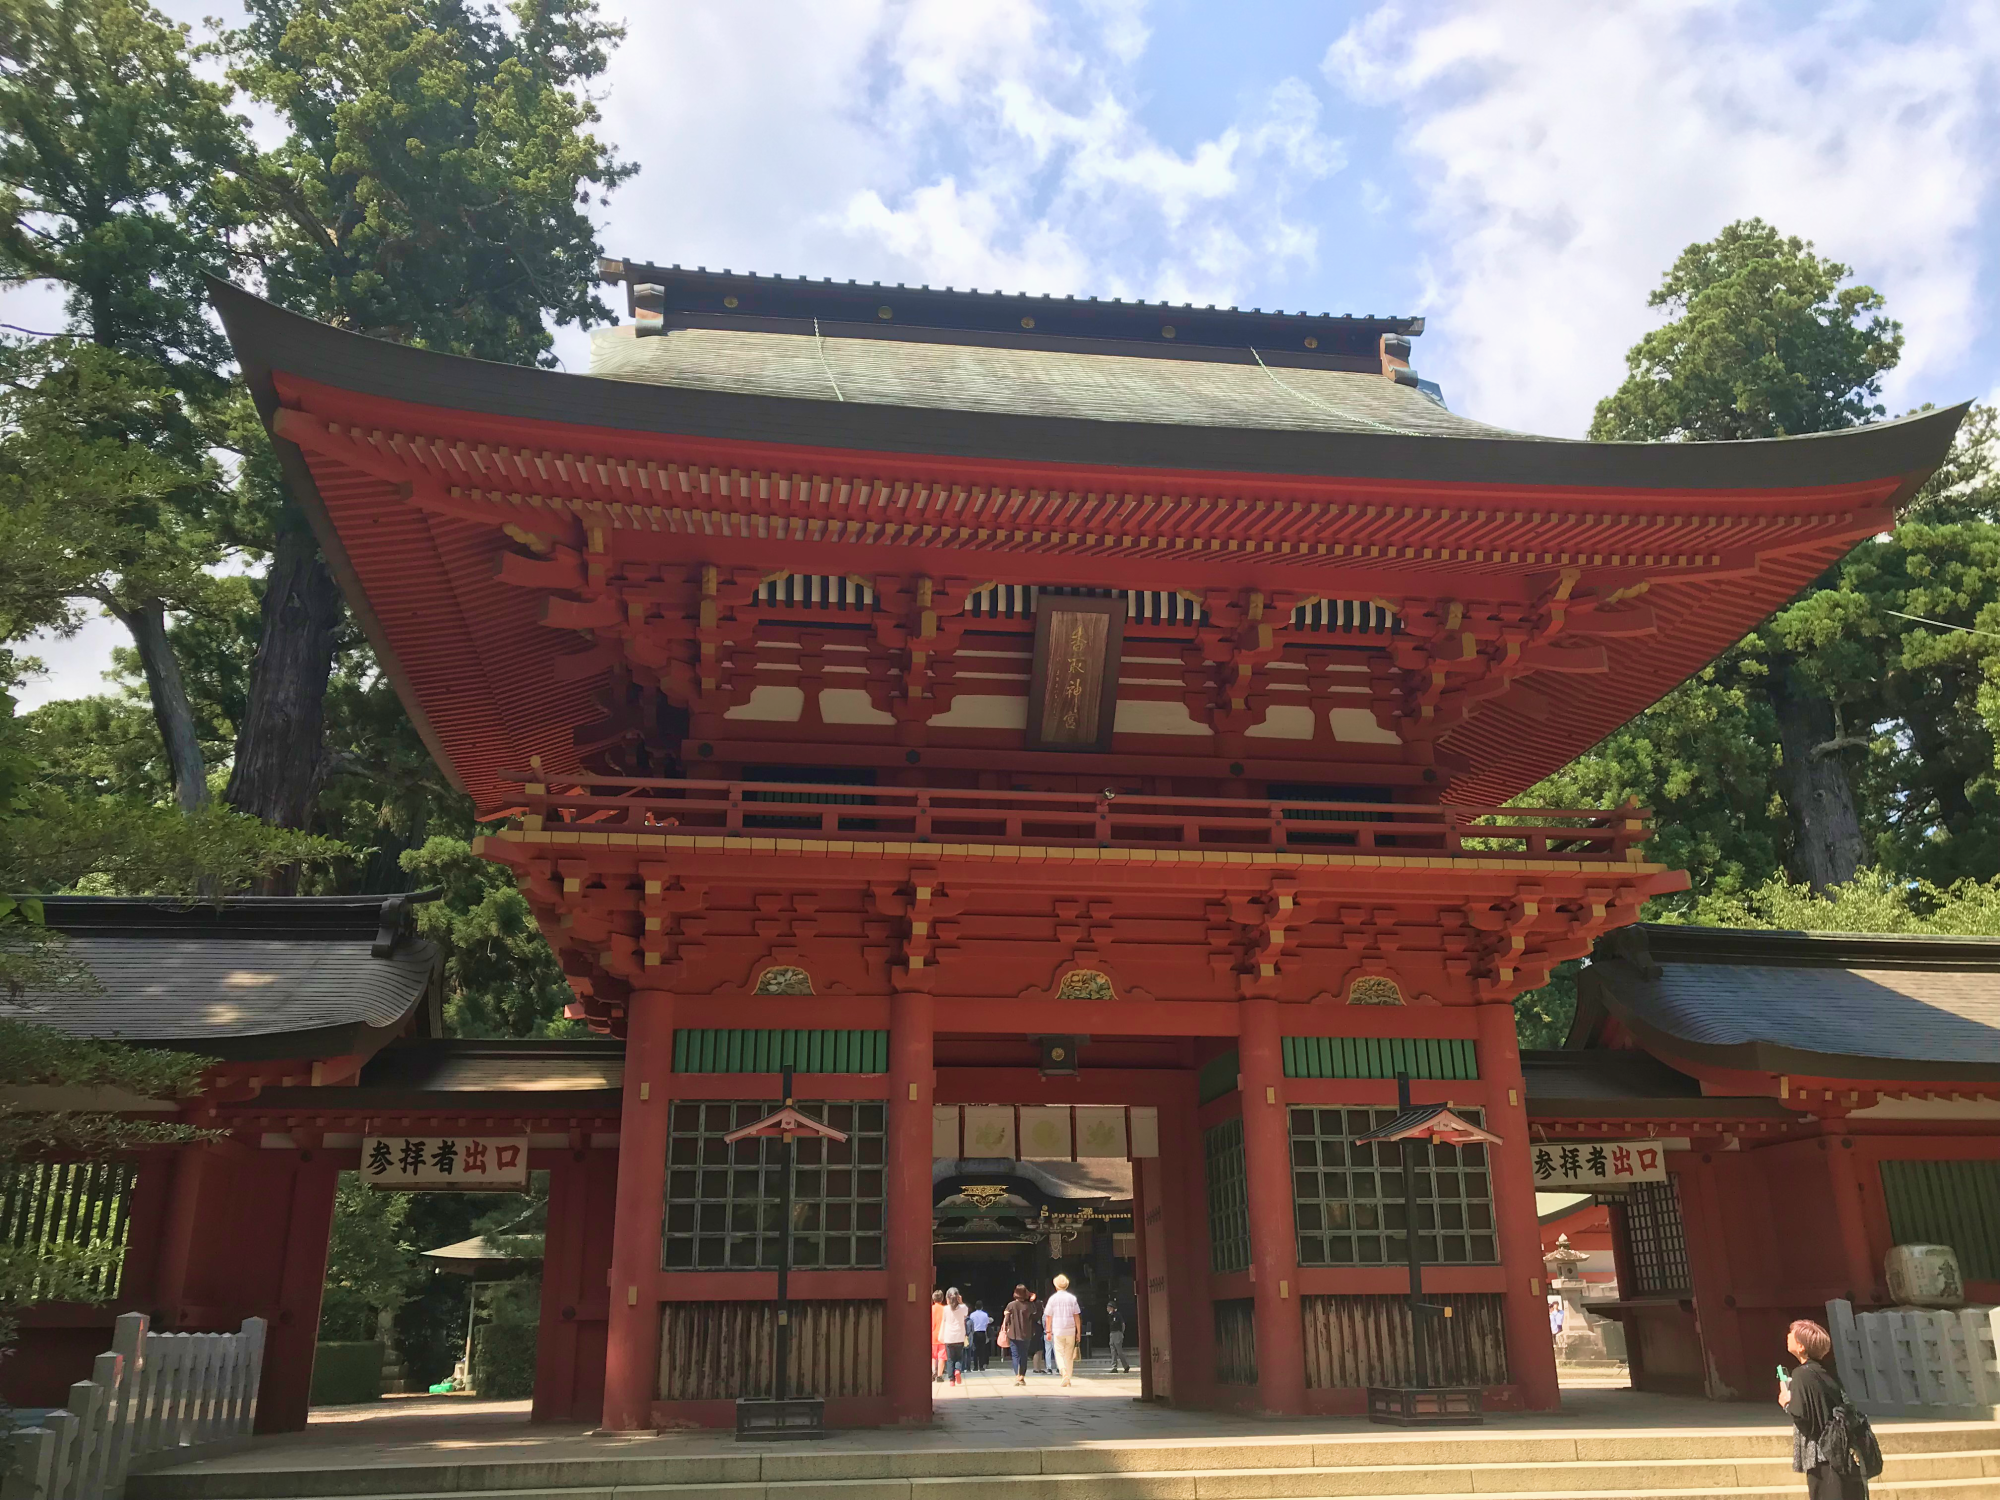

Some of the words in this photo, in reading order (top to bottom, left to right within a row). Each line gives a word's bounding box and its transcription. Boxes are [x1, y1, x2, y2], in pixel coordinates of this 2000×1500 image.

[1062, 624, 1088, 729] 香取神宮
[366, 1138, 521, 1176] 参拝者出口
[1534, 1145, 1658, 1180] 参拝者出口
